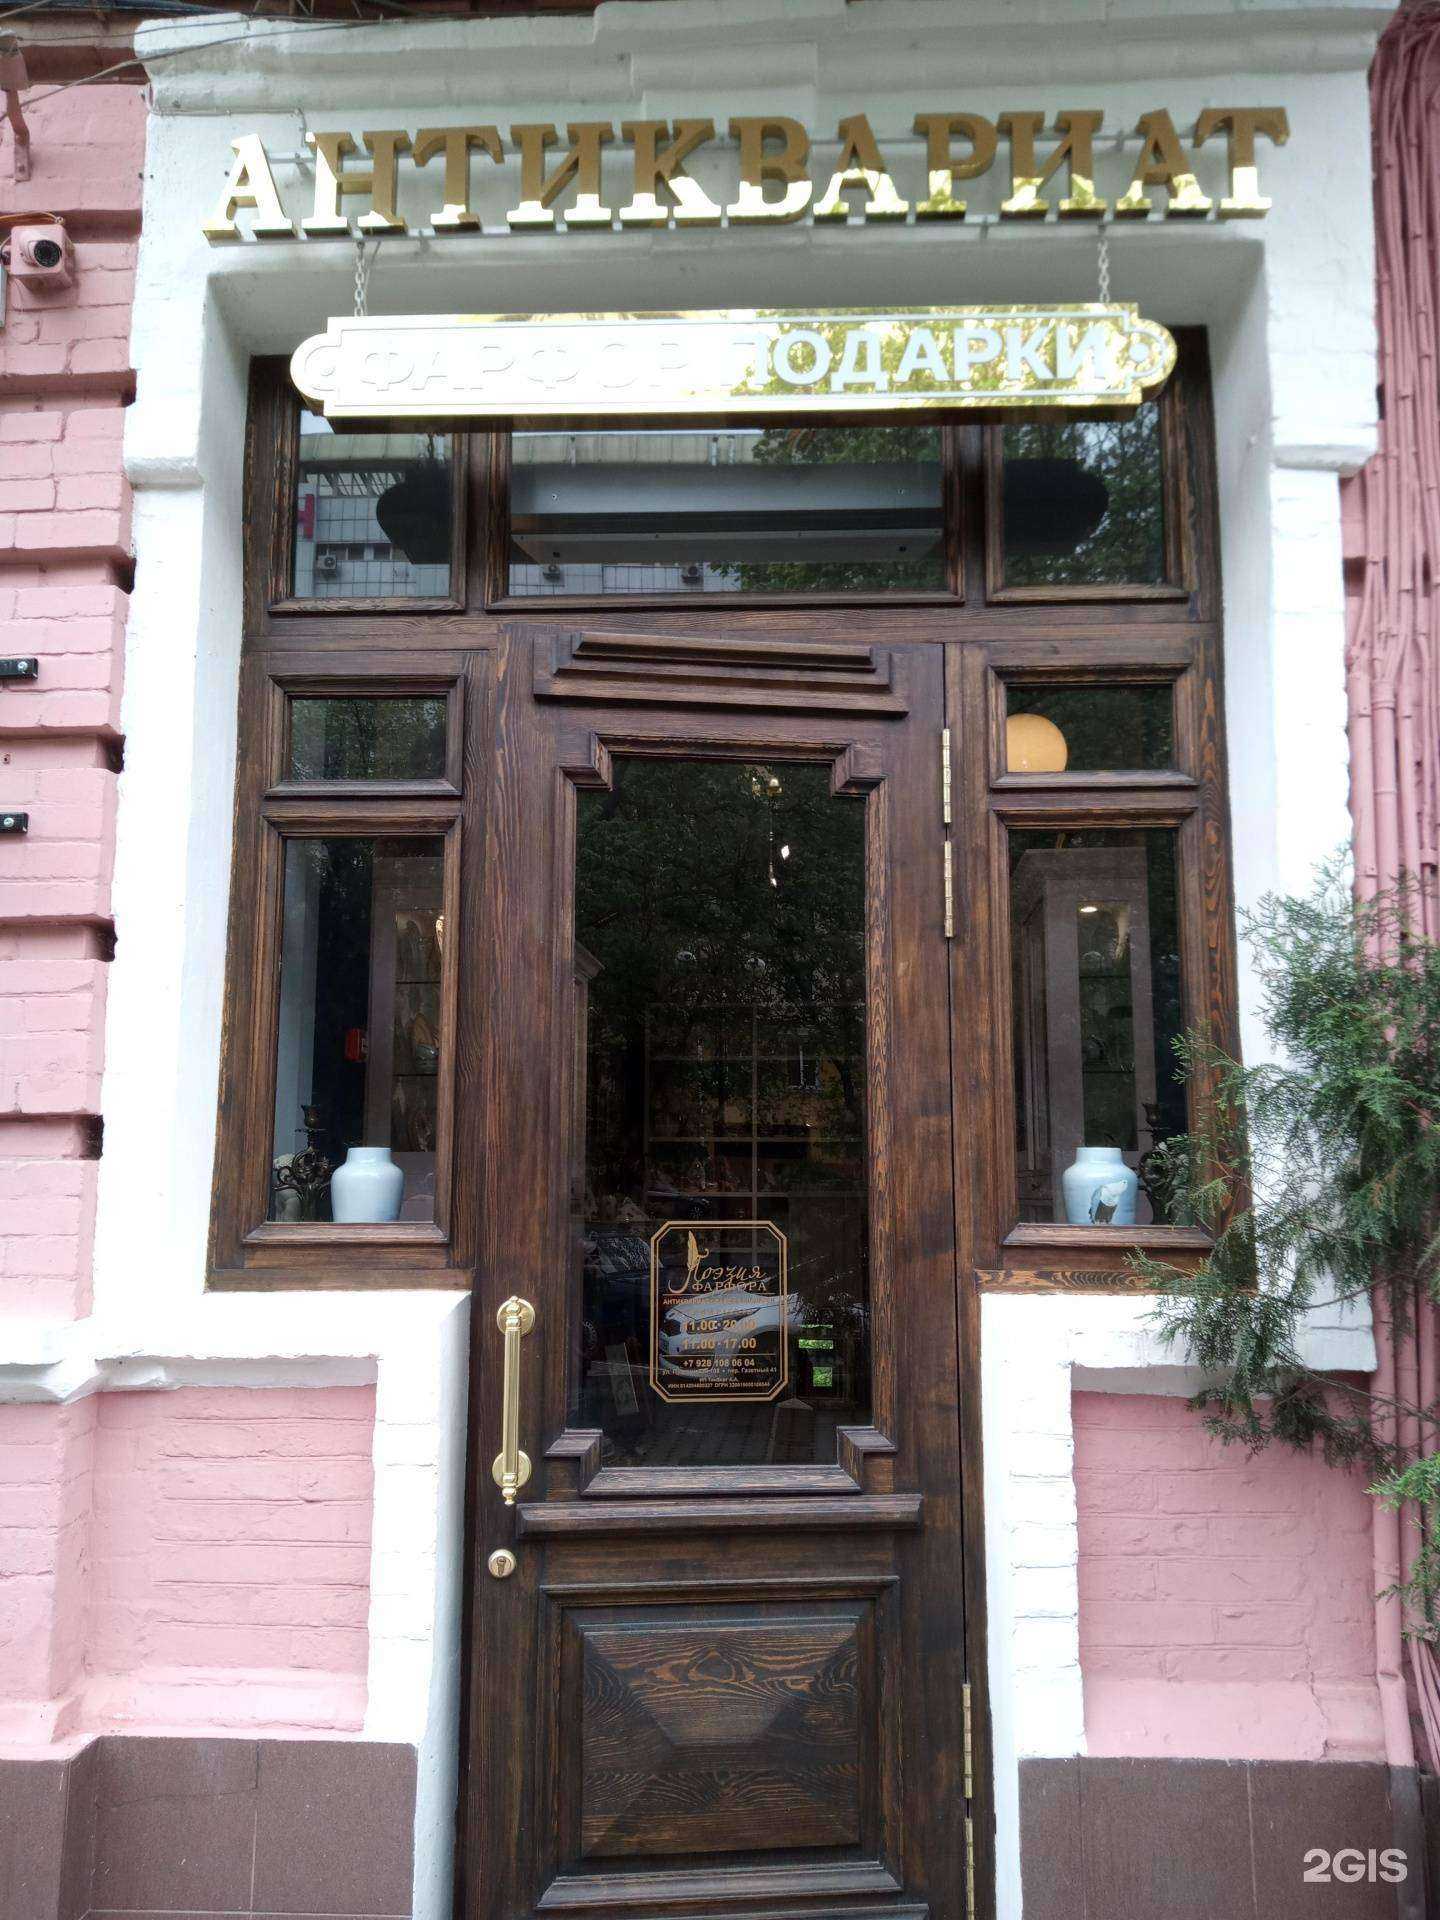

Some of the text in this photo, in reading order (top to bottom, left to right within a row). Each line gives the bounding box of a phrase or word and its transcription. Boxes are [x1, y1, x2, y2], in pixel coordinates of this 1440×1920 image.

[200, 106, 1290, 238] АНТИКВАРИАТ
[719, 324, 1108, 393] ПОДАРКИ
[667, 1230, 770, 1294] Поэзия
[691, 1280, 768, 1293] ФАРФОРА
[683, 1337, 757, 1350] 11.00 17.00
